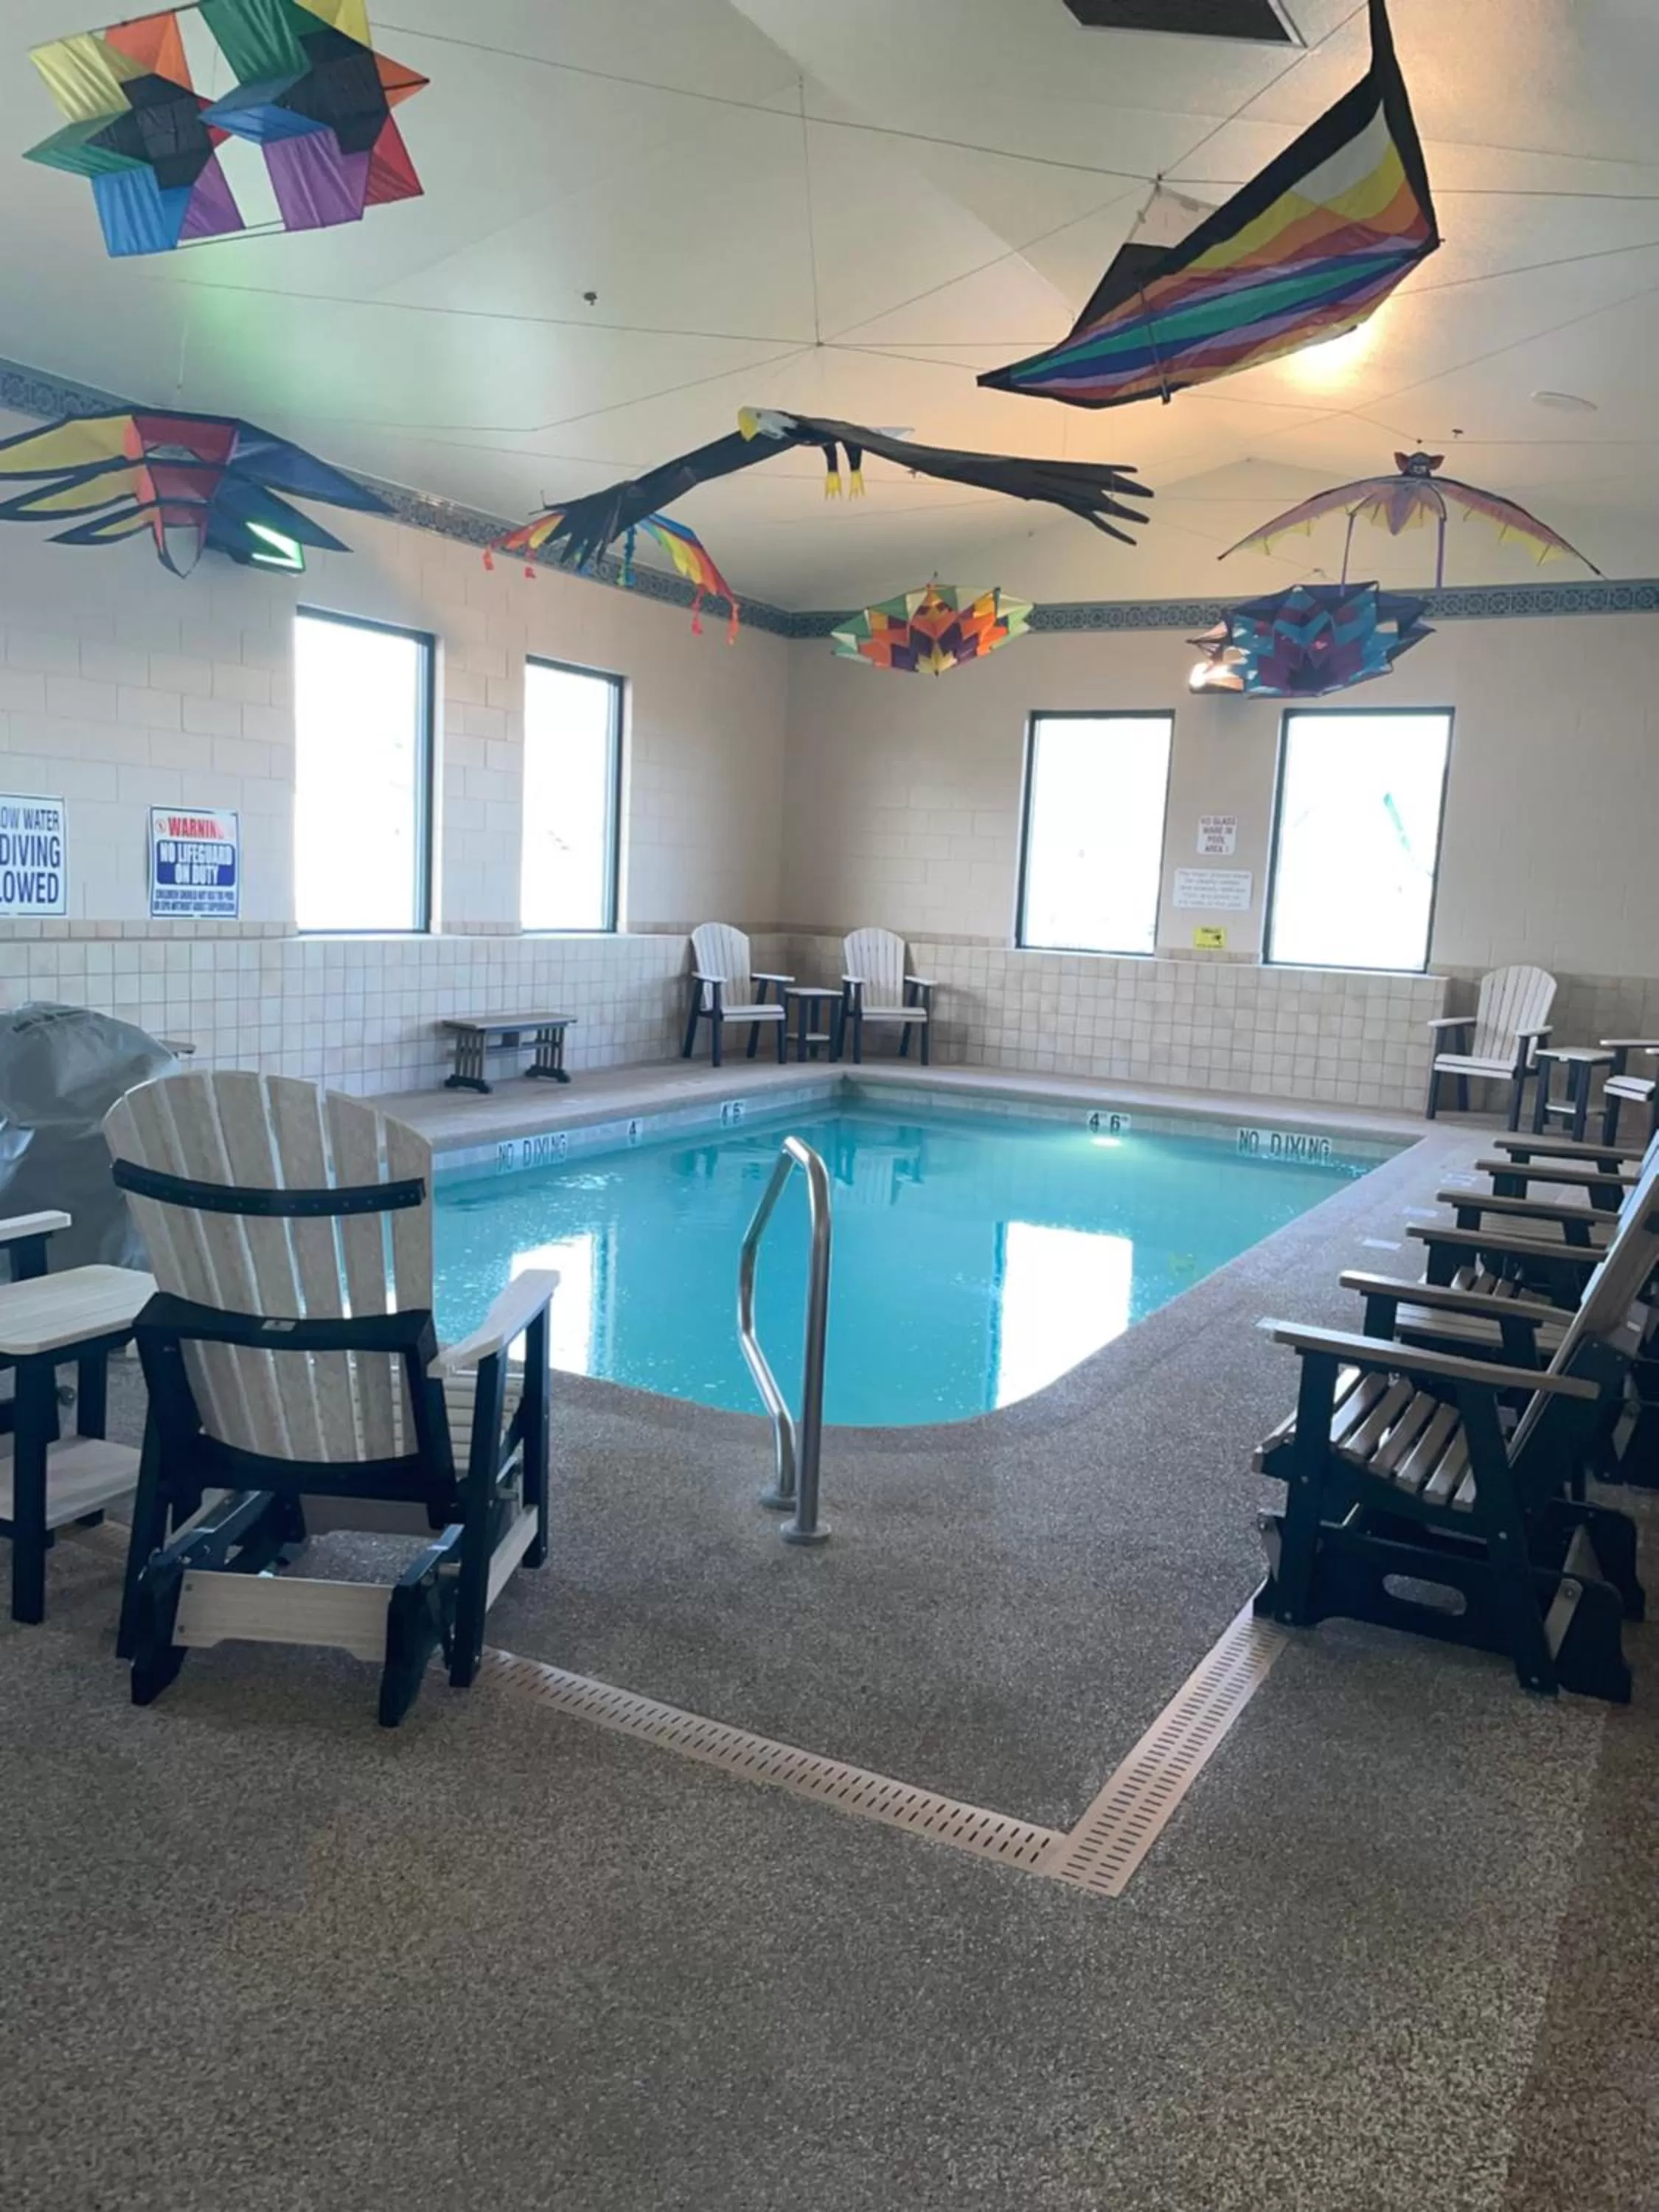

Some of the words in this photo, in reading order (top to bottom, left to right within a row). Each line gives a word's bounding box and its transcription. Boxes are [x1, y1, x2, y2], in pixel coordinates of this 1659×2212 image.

[0, 807, 19, 830] OW
[23, 807, 60, 832] WATER
[0, 834, 60, 868] DIVING
[159, 842, 175, 863] NO
[177, 843, 232, 866] LIFEGUARD
[175, 863, 189, 884] ON
[192, 864, 218, 886] DUTY
[0, 871, 60, 903] OWED
[1239, 1129, 1259, 1153] NO
